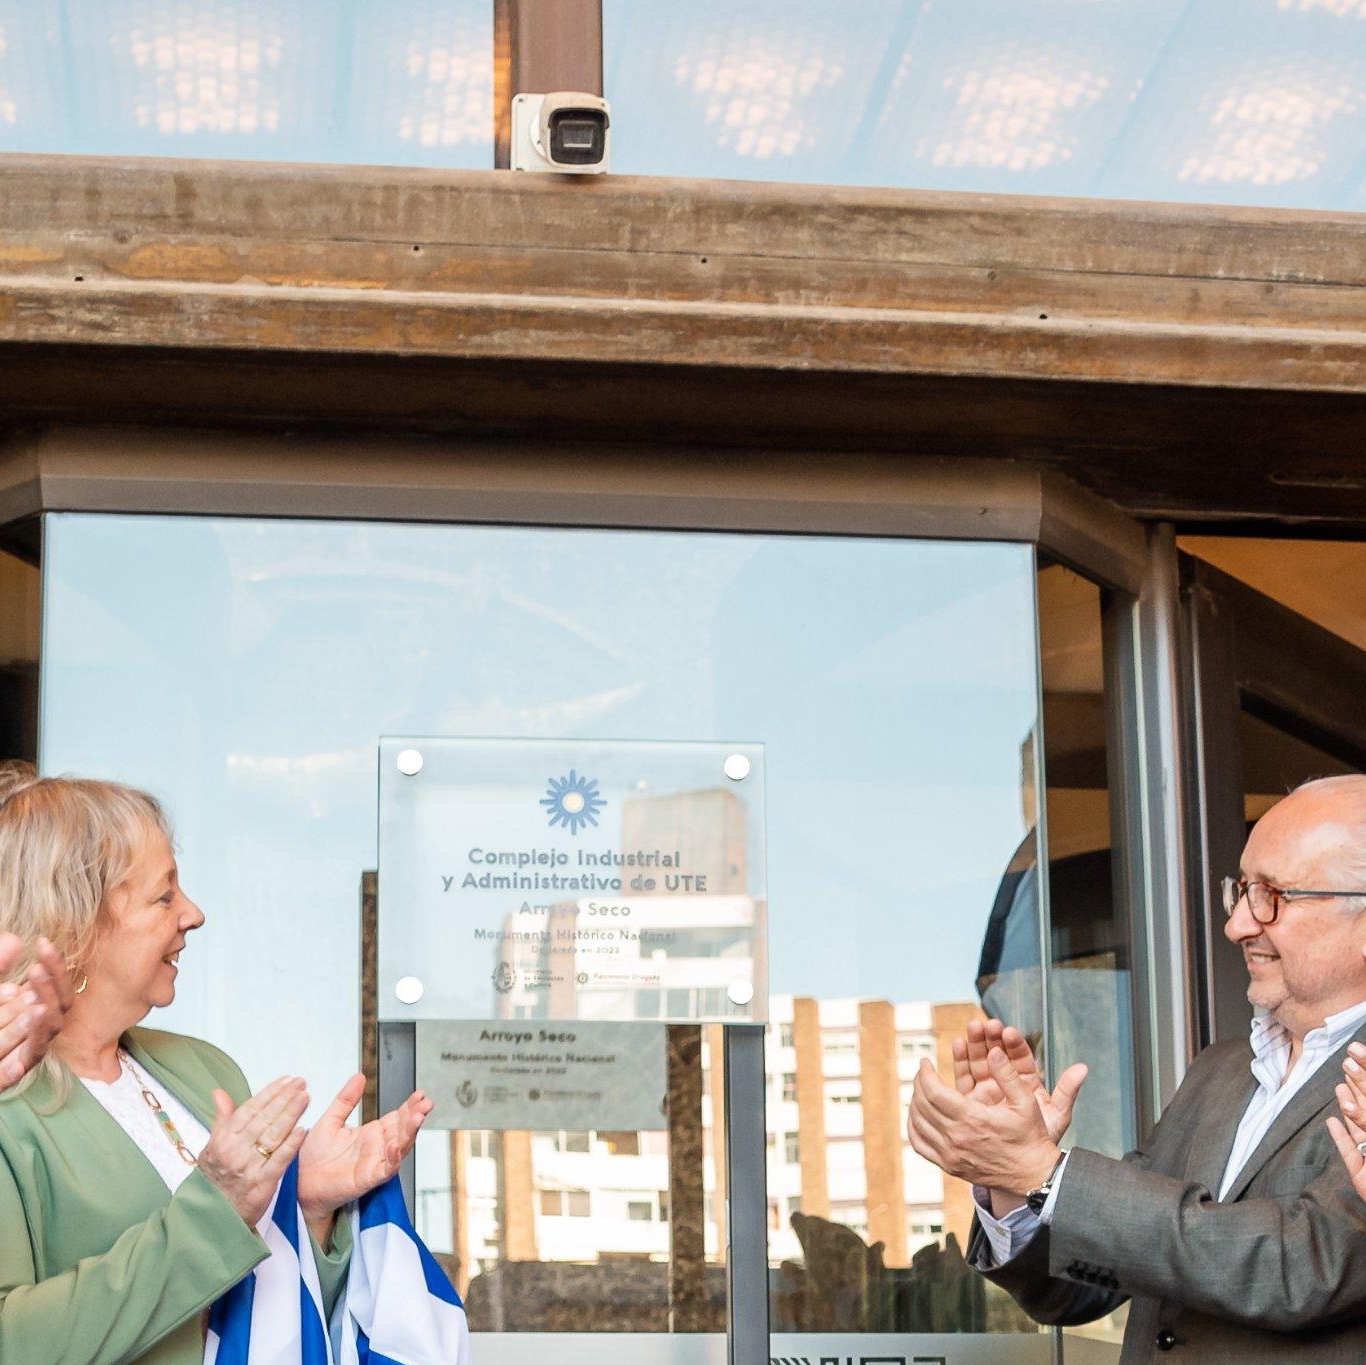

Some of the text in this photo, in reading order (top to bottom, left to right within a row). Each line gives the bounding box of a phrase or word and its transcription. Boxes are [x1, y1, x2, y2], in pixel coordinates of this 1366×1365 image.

[468, 848, 680, 868] Complejo Industrial
[442, 872, 707, 892] y Administrativo de UTE
[588, 902, 631, 916] Seco
[479, 1030, 577, 1044] Arroyo Seco
